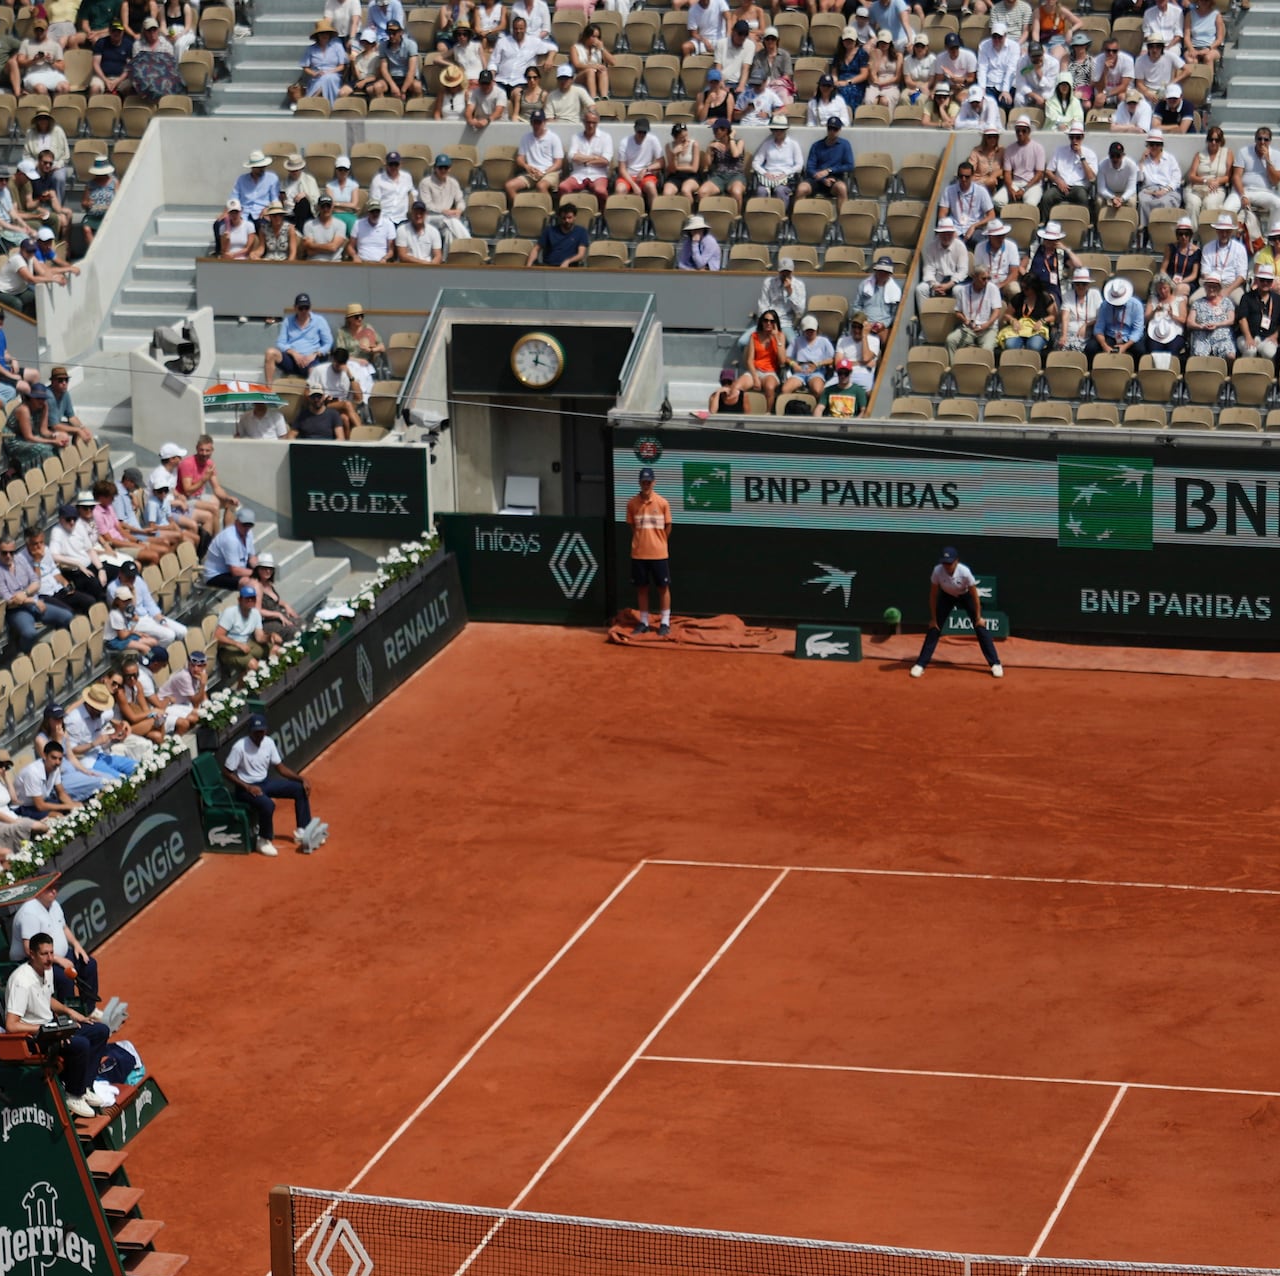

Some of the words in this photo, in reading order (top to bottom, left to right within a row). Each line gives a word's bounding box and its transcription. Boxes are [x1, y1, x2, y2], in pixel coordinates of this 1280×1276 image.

[307, 492, 410, 516] ROLEX
[744, 475, 811, 507] BNP
[819, 479, 960, 511] PARIBAS
[474, 526, 541, 556] Infosys
[1080, 590, 1139, 613] BNP
[1148, 592, 1272, 621] PARIBAS
[384, 590, 451, 669] RENAULT
